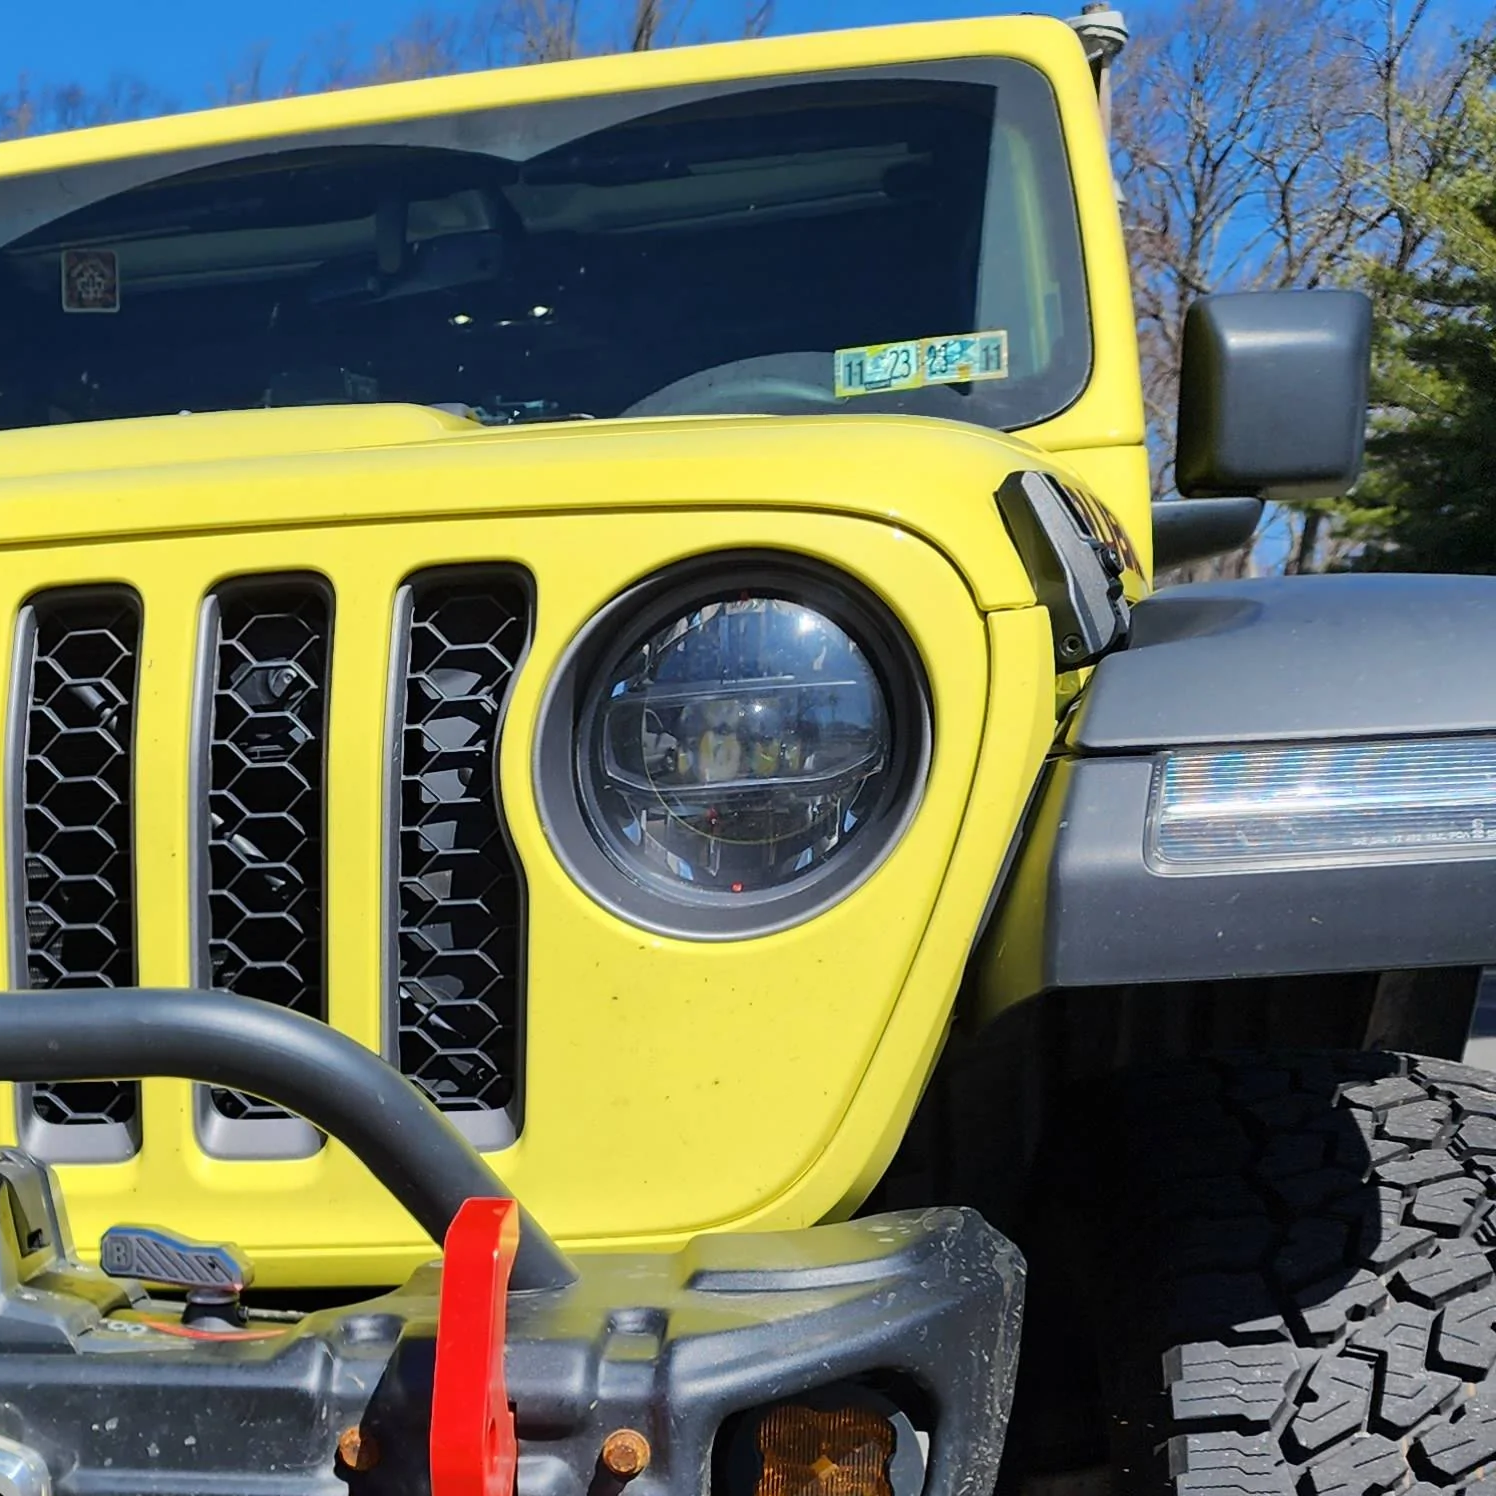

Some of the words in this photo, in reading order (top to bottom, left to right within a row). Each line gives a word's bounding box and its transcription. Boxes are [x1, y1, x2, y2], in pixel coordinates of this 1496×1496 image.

[845, 358, 865, 387] 11
[888, 349, 912, 379] 23
[981, 343, 1002, 372] 11
